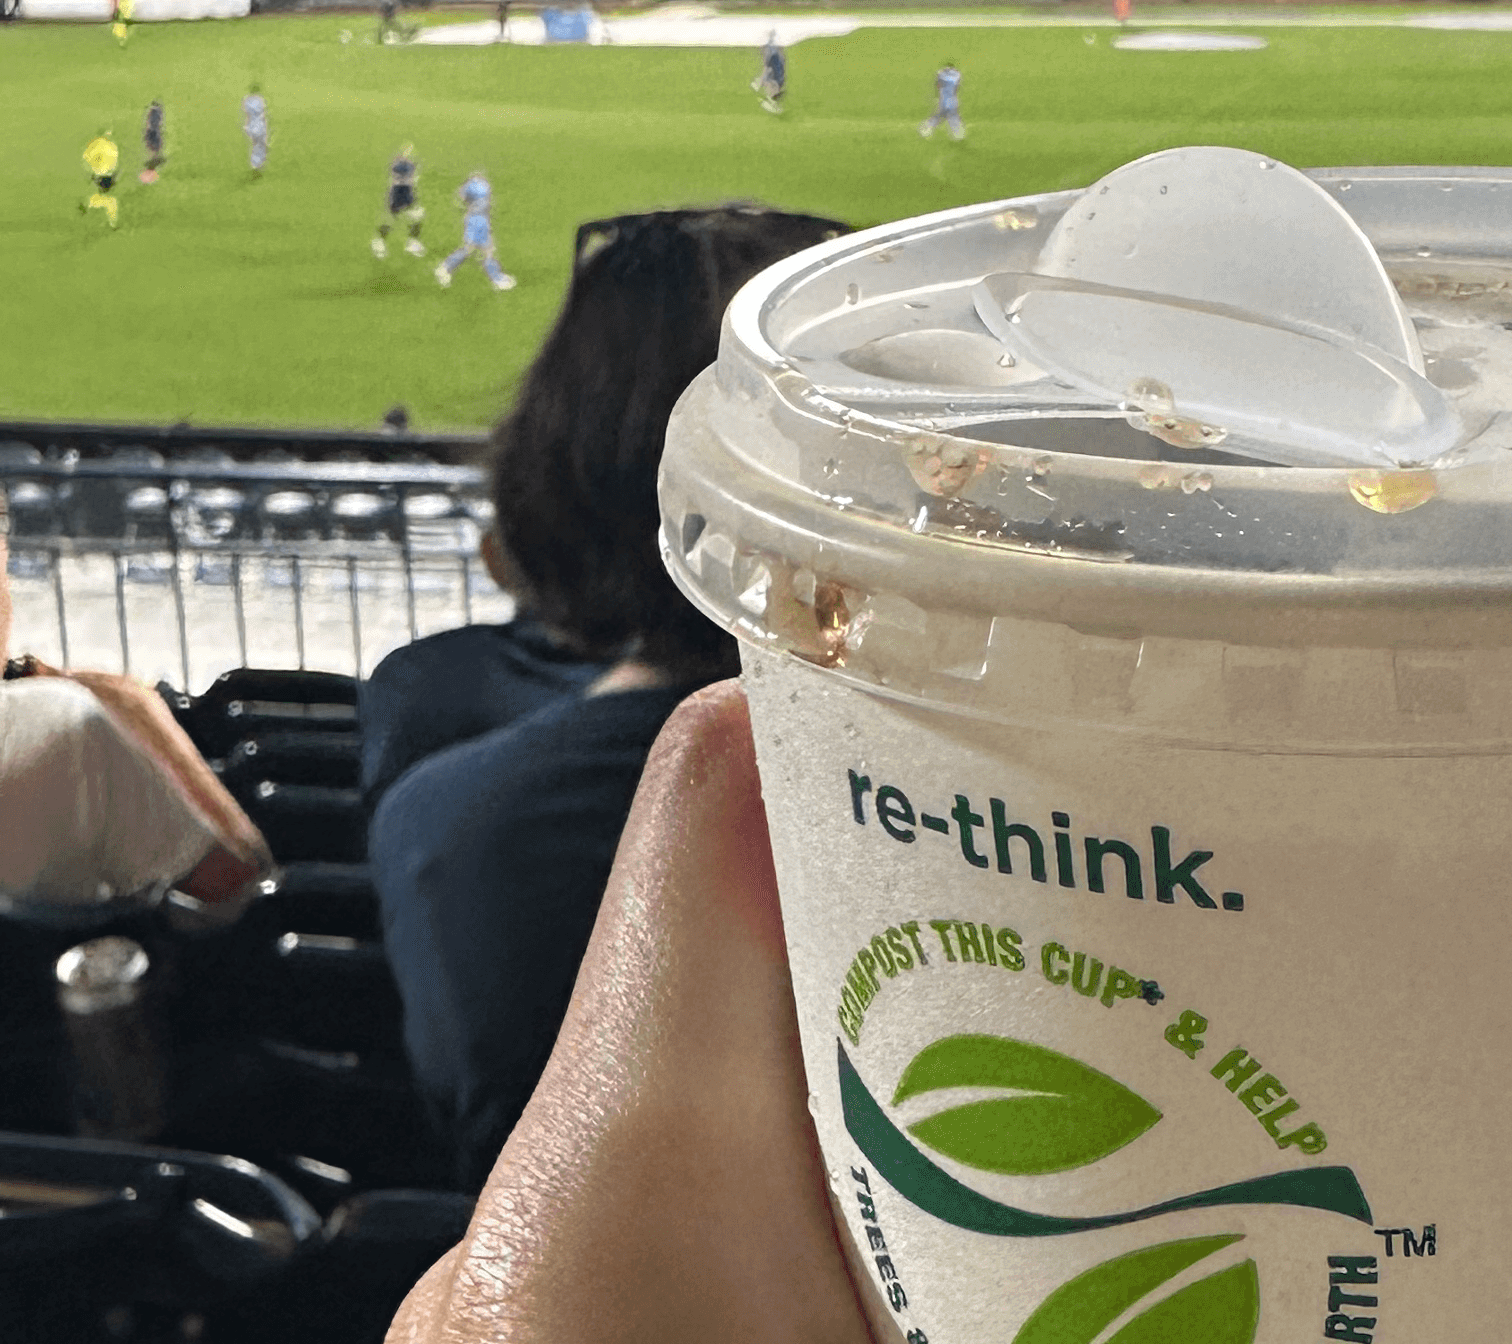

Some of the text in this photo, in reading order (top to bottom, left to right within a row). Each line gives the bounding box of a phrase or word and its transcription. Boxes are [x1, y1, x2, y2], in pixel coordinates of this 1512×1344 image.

[847, 767, 1245, 912] re-think.
[929, 919, 1025, 973] THIS
[1164, 1008, 1209, 1059] &
[1209, 1045, 1329, 1156] HELP
[851, 1164, 908, 1315] TREES
